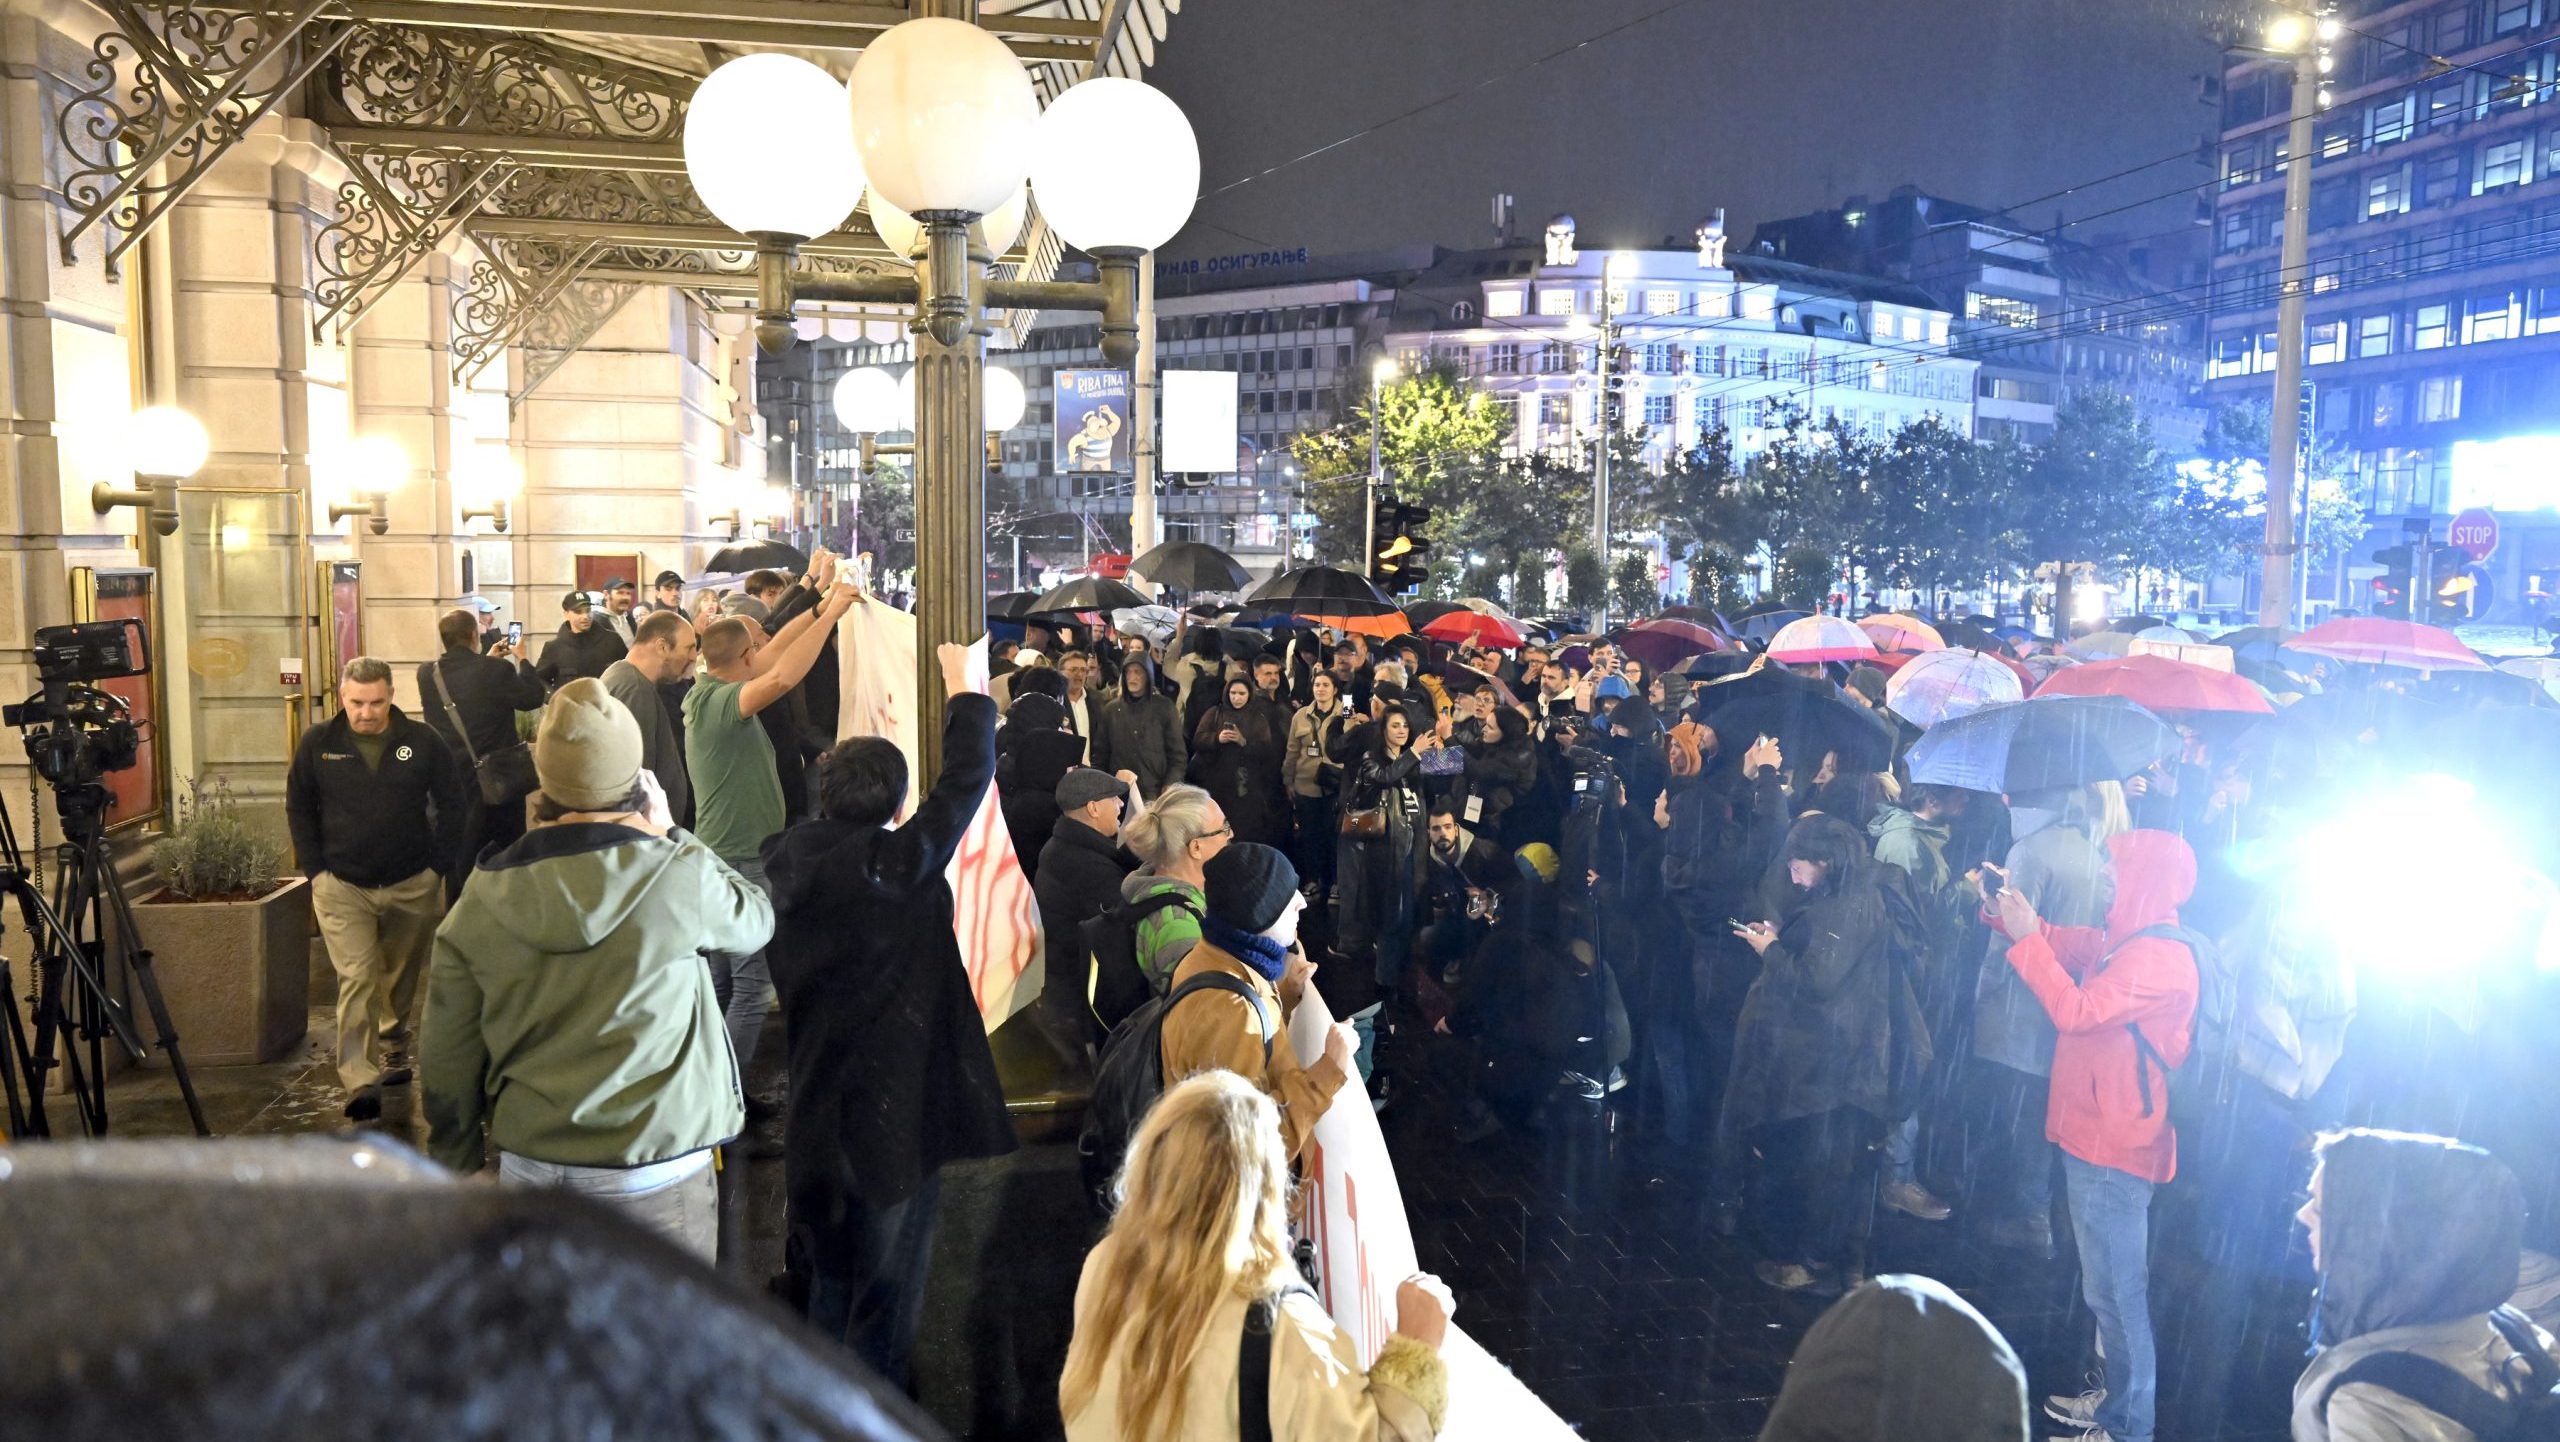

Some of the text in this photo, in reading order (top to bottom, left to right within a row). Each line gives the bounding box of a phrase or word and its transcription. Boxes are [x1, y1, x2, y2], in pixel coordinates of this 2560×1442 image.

[1208, 248, 1308, 272] ОСИГУРАЊЕ
[1078, 376, 1101, 393] RIBA
[1104, 374, 1124, 388] FINA
[2456, 526, 2492, 545] STOP
